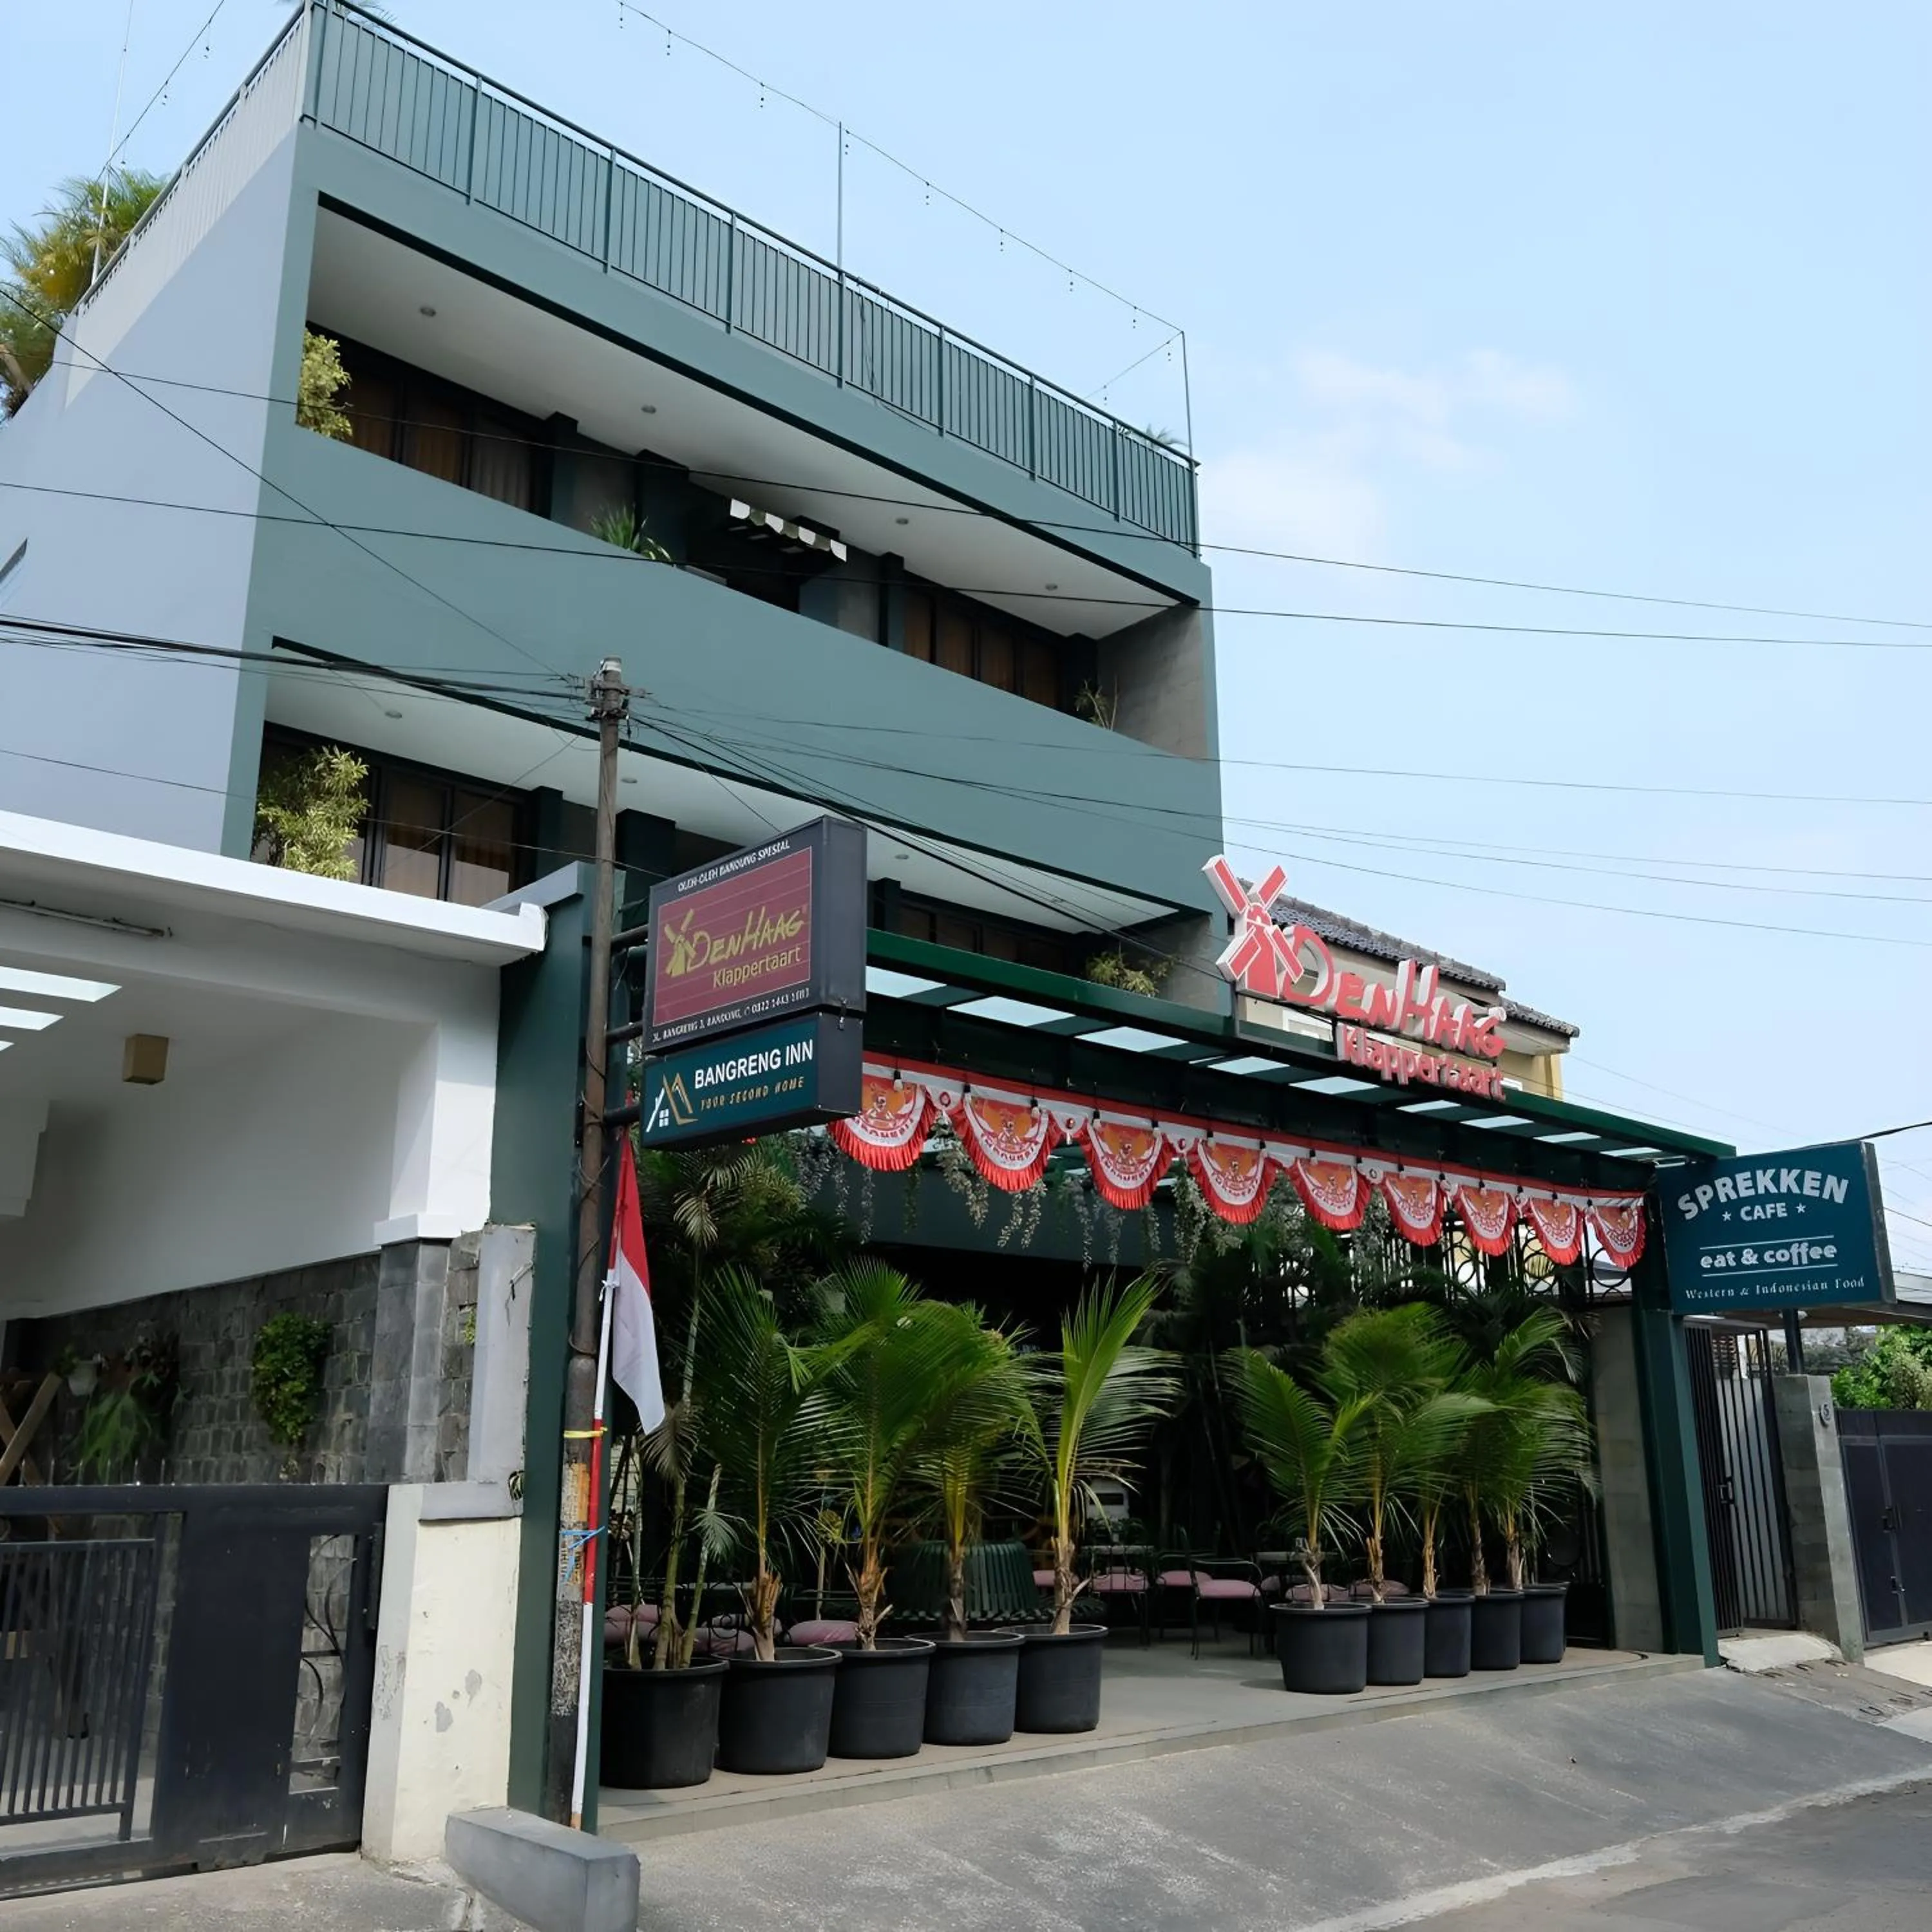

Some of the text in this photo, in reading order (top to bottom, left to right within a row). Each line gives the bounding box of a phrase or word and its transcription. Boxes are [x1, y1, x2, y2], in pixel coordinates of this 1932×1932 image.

[712, 947, 801, 990] Klappertaart
[694, 1038, 813, 1089] BANGRENG INN
[1335, 1021, 1506, 1103] Klappertaart
[1677, 1168, 1850, 1220] SPREKKEN
[1740, 1202, 1788, 1222] CAFE
[1700, 1242, 1837, 1269] eat & coffee
[1685, 1289, 1735, 1300] Western
[1756, 1280, 1828, 1296] Indonesian
[1835, 1275, 1865, 1289] Food
